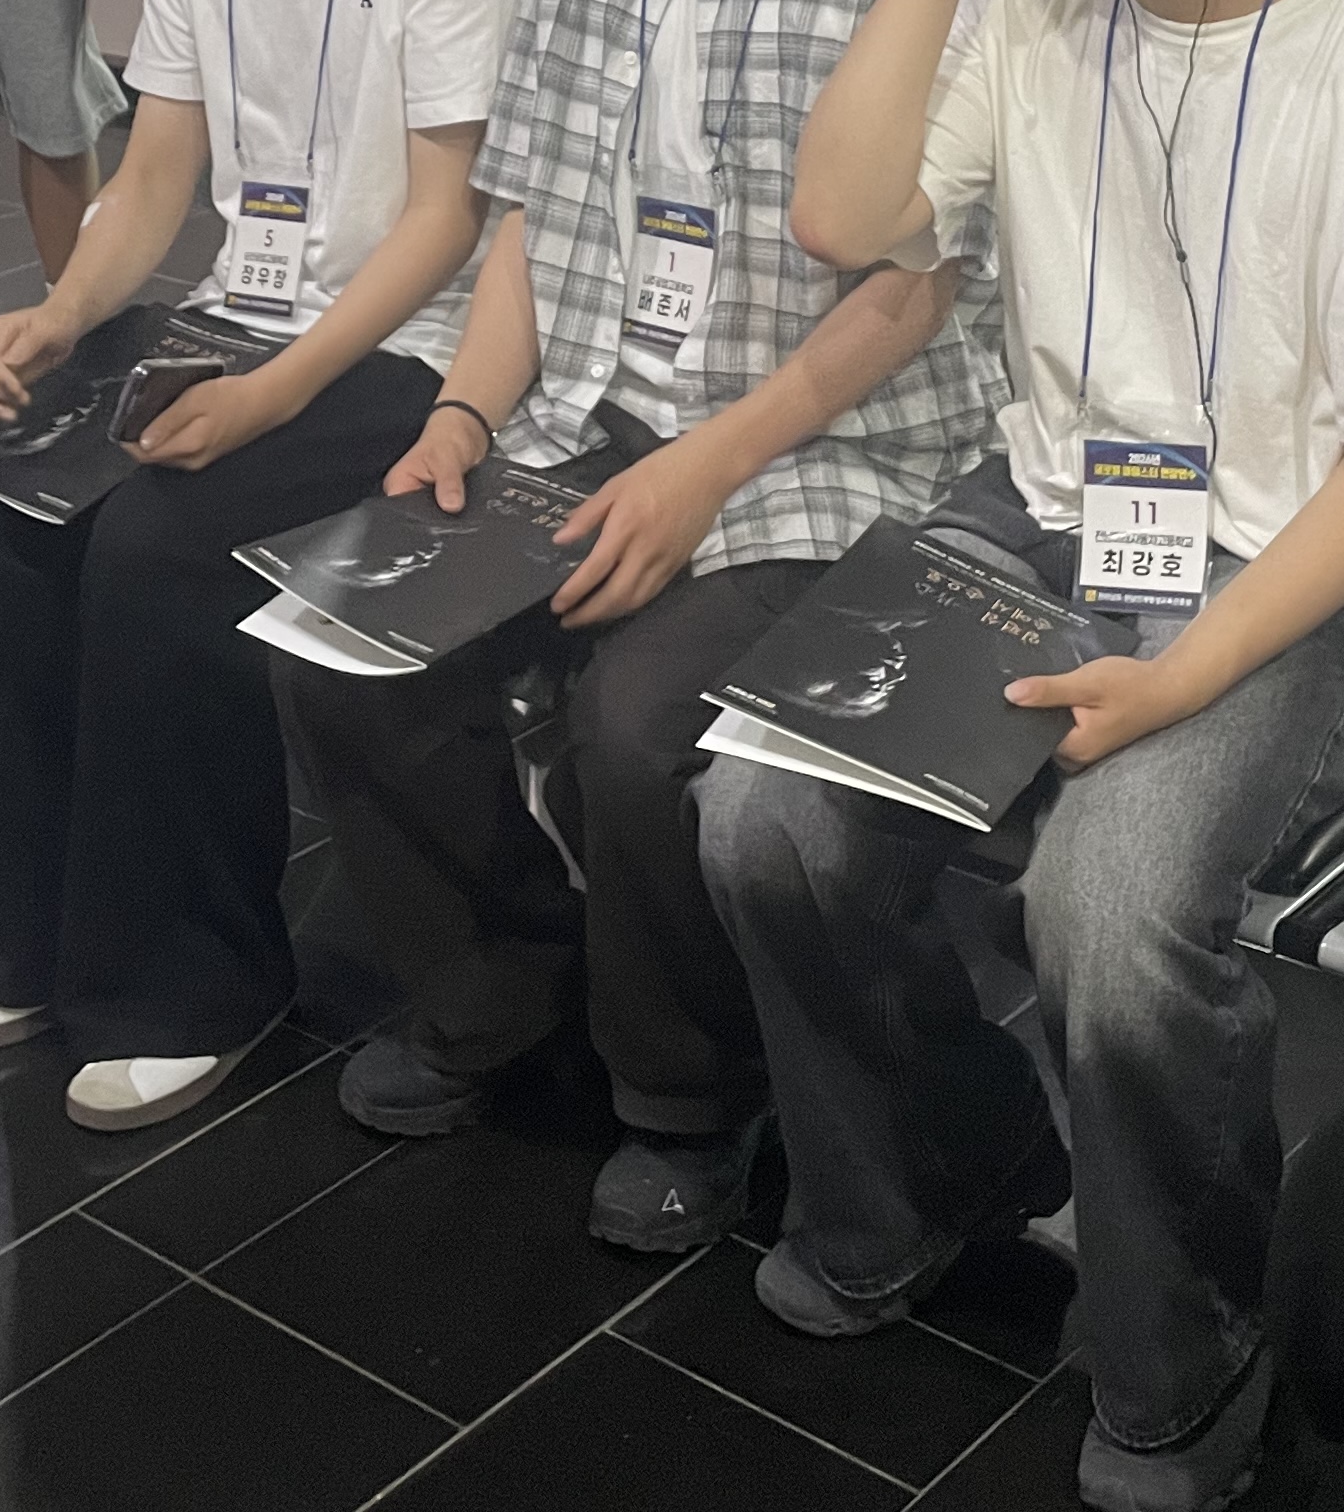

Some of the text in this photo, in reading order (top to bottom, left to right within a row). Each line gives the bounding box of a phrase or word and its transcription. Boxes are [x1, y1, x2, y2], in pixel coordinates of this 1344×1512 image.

[264, 229, 274, 247] 5
[669, 251, 676, 273] 1
[1131, 500, 1157, 524] 11
[1102, 549, 1183, 578] 최강호
